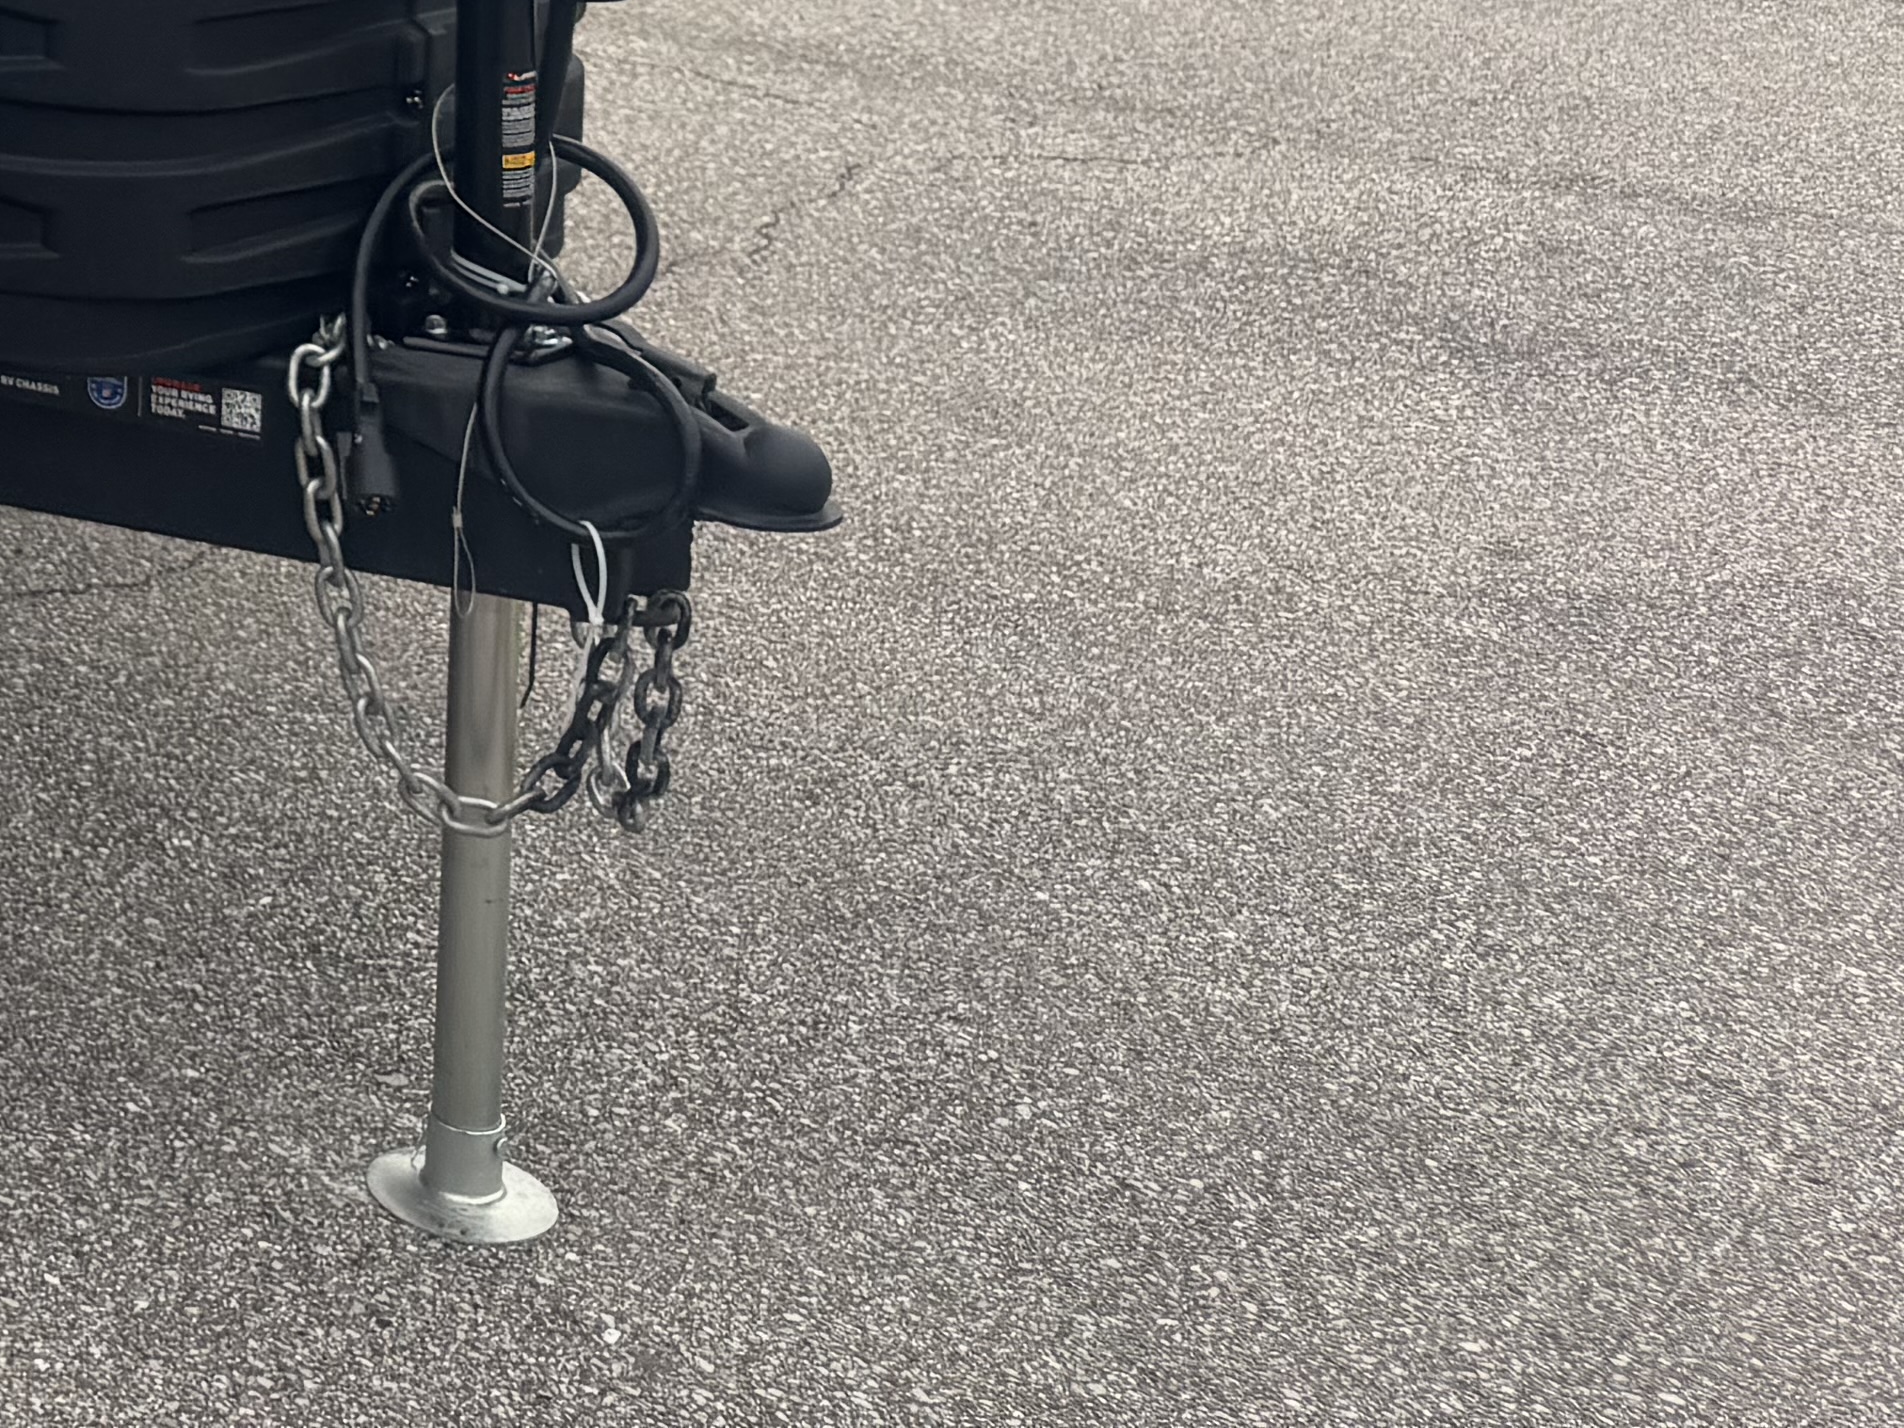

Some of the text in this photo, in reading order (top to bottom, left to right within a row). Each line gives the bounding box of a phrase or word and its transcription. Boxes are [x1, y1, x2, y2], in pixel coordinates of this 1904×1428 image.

[0, 375, 60, 396] RV CHASSIS
[151, 384, 178, 398] YOUR
[150, 393, 217, 415] EXPERIENCE
